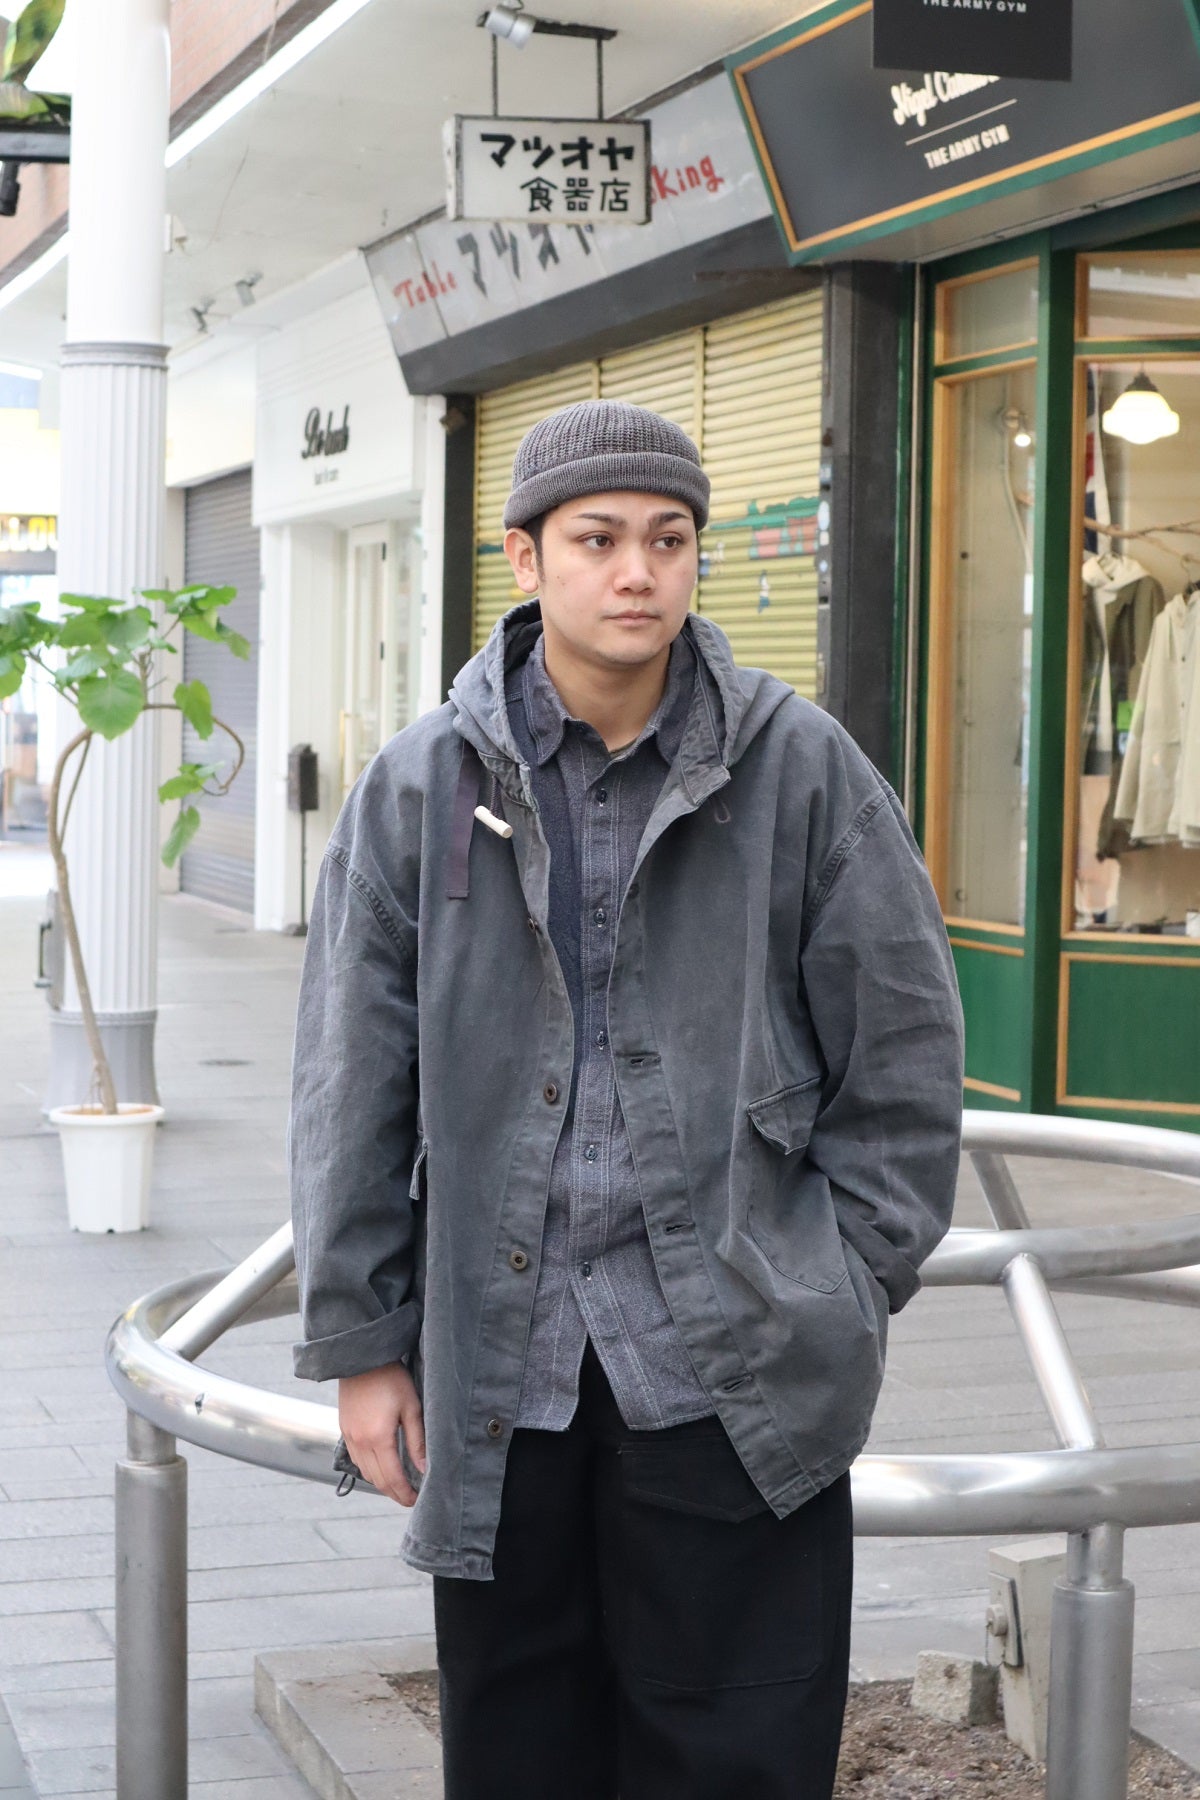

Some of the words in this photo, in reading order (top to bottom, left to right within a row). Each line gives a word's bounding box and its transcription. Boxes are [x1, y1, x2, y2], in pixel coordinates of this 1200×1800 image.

[953, 0, 992, 10] ARMY
[996, 1, 1027, 13] GYM
[480, 132, 635, 171] マツオヤ
[924, 147, 950, 169] THE
[949, 134, 981, 161] ARMY
[981, 124, 1010, 148] GYM
[520, 176, 632, 212] 食器店
